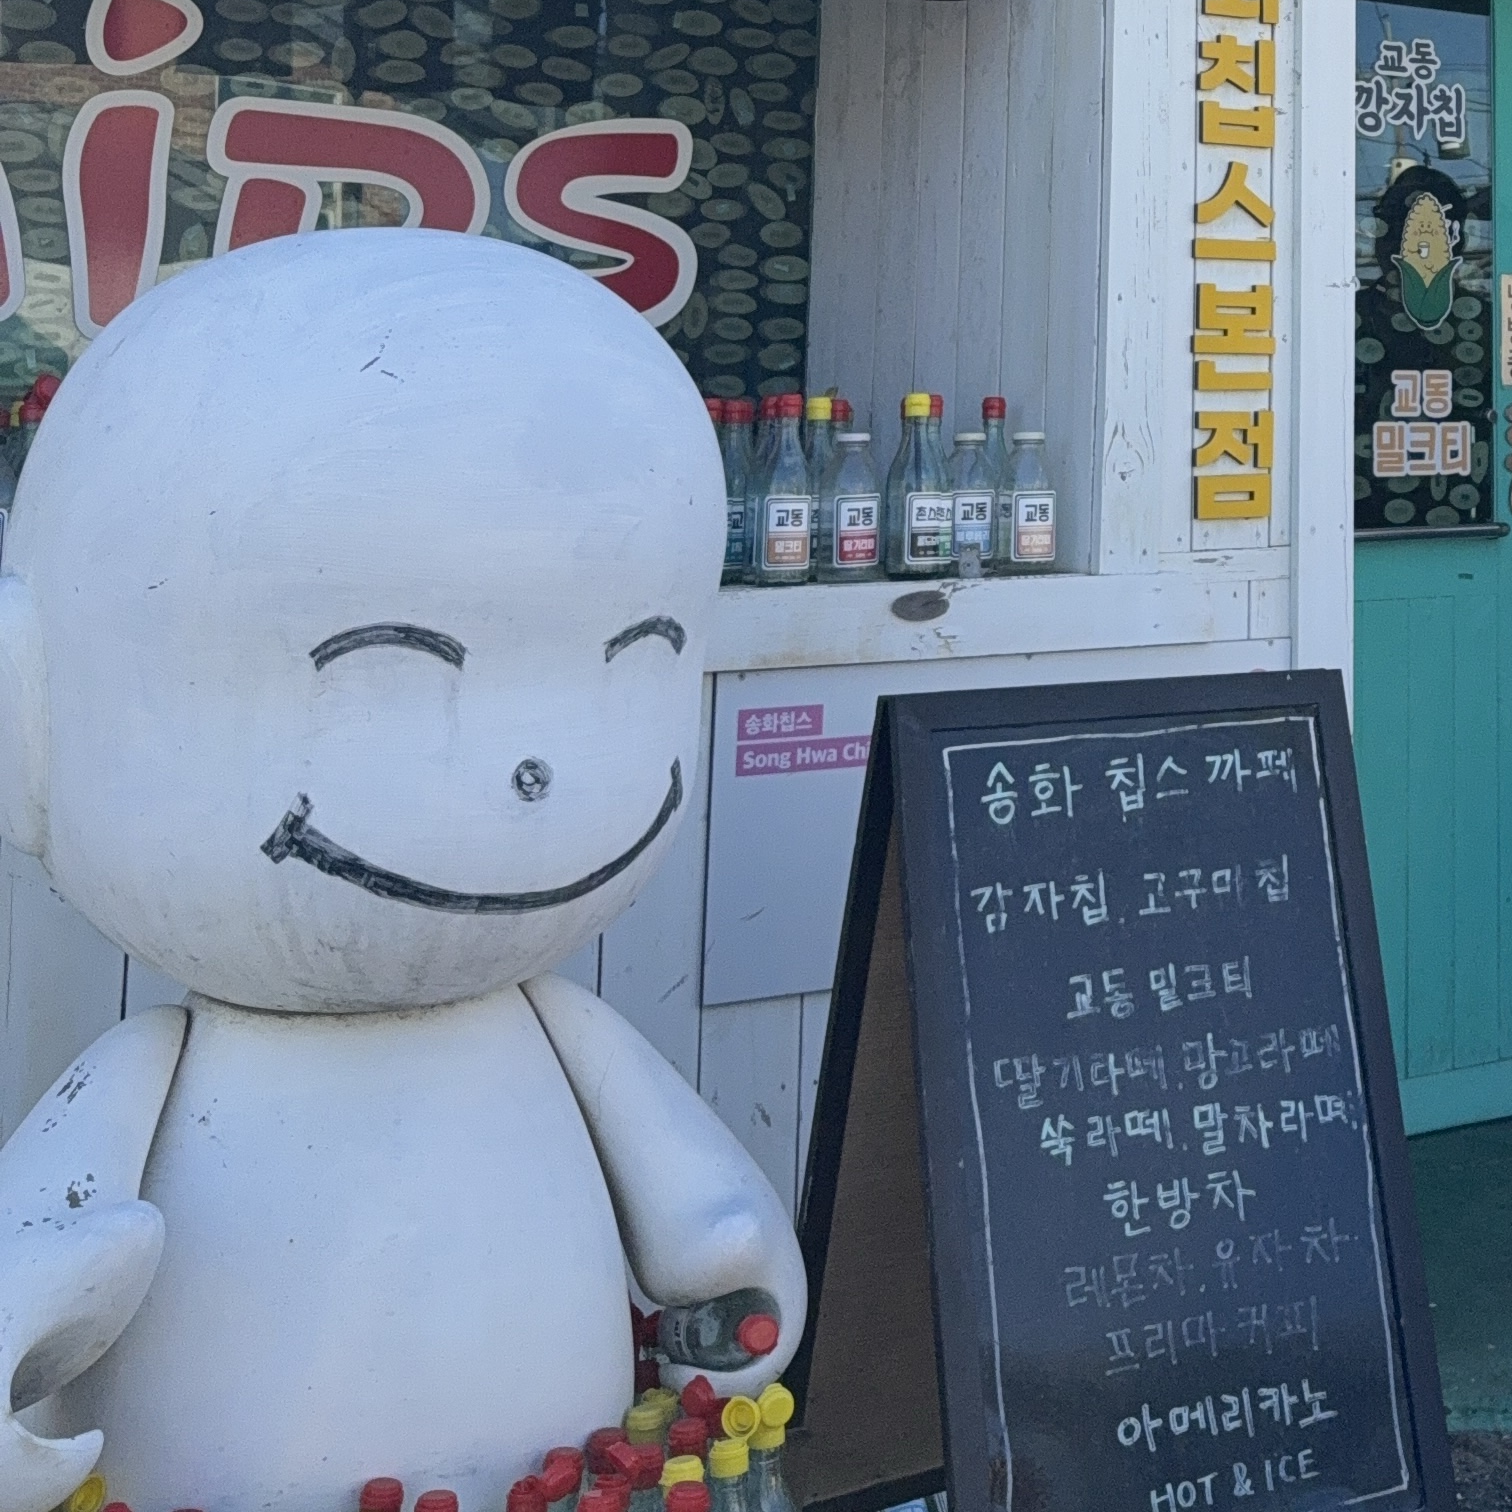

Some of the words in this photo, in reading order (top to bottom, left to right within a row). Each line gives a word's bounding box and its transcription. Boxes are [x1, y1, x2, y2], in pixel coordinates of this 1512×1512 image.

[1375, 39, 1441, 84] 교동
[1356, 76, 1466, 142] 깡자칩
[1391, 369, 1452, 418] 교동
[1373, 421, 1471, 476] 밀크티
[776, 508, 803, 527] 교동
[847, 506, 874, 527] 교동
[961, 502, 988, 521] 교동
[1025, 503, 1050, 522] 교동
[745, 710, 813, 736] 송화칩스
[743, 750, 791, 770] Song
[797, 746, 837, 765] Hwa
[981, 761, 1083, 825] 송화
[1105, 752, 1189, 814] 칩스
[1204, 747, 1298, 794] 까페
[1066, 967, 1135, 1020] 교동
[1149, 954, 1253, 1013] 밀크티
[1102, 1169, 1257, 1237] 한방차
[1116, 1378, 1339, 1452] 아메리카노
[1149, 1471, 1219, 1512] HOT
[1232, 1461, 1255, 1496] &
[1264, 1448, 1322, 1492] ICE
